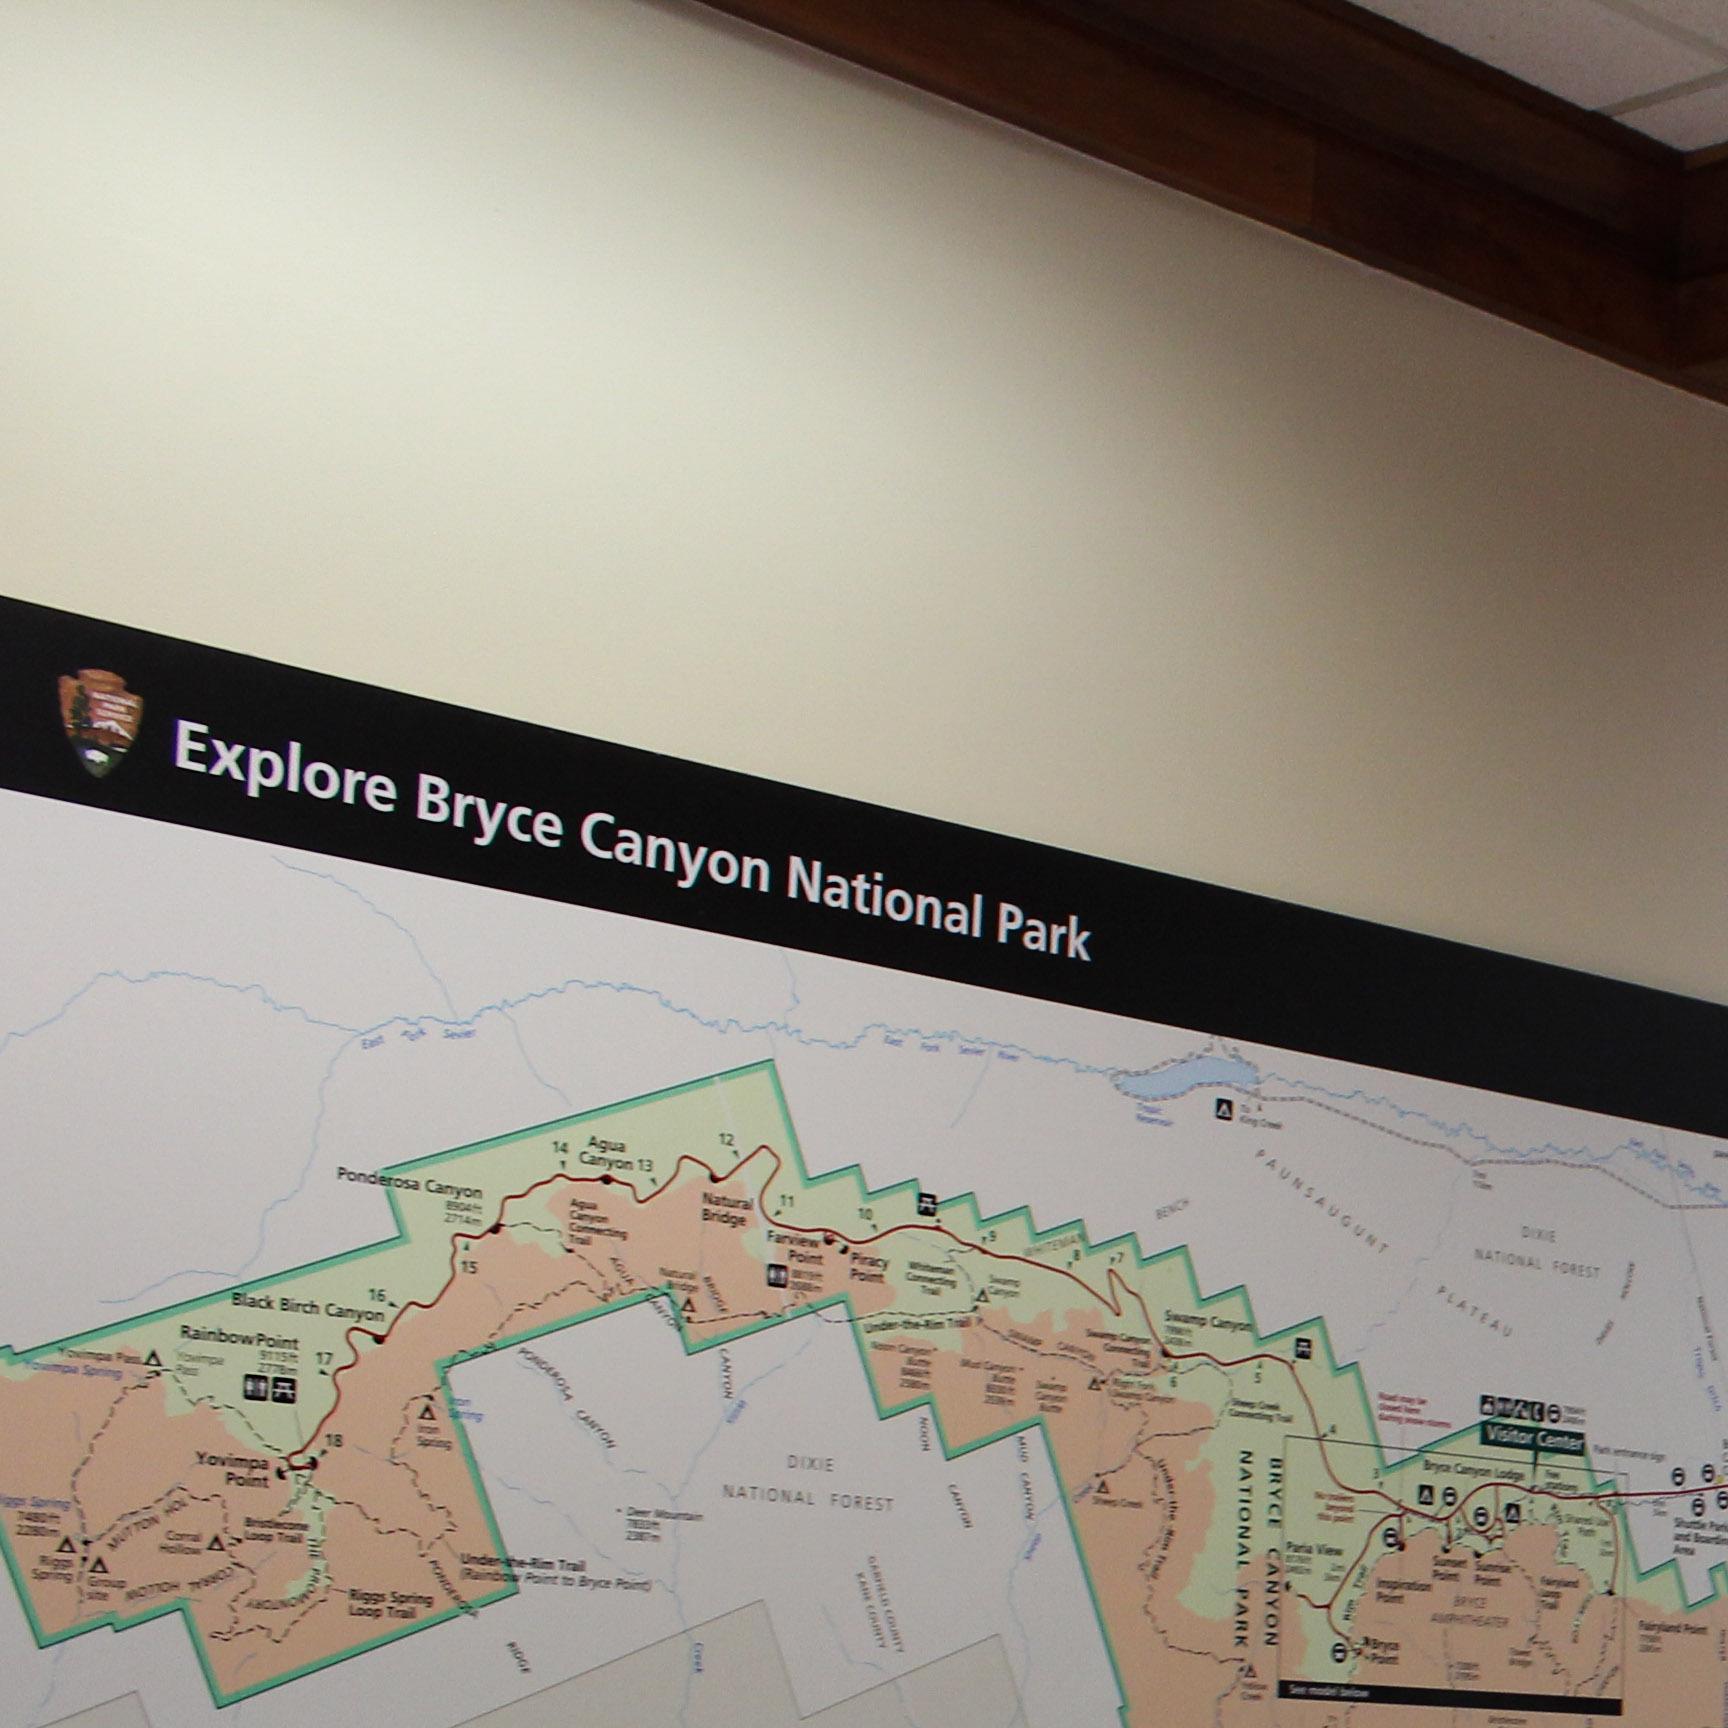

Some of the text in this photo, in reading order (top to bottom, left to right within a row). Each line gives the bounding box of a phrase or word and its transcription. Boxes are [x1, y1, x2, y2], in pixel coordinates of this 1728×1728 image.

[172, 717, 1092, 962] Explore Bryce Canyon National Park
[589, 1136, 626, 1153] Agua
[719, 1133, 735, 1146] 12
[579, 1151, 634, 1171] Canyon
[637, 1159, 654, 1172] 13
[336, 1166, 483, 1200] Ponderosa Canyon
[702, 1192, 754, 1211] Natural
[702, 1209, 747, 1229] Bridge
[788, 1251, 824, 1265] Point
[851, 1252, 889, 1270] Piracy
[460, 1261, 478, 1275] 15
[851, 1269, 884, 1283] Point
[369, 1289, 385, 1302] 16
[231, 1292, 385, 1323] Black Birch Canyon
[181, 1325, 299, 1351] Rainbow Point
[316, 1352, 334, 1365] 17
[326, 1433, 343, 1447] 18
[1486, 1424, 1585, 1451] Visitor Center
[196, 1451, 269, 1470] Yovimpa
[786, 1453, 836, 1472] DIXIE
[1423, 1458, 1525, 1482] Bryce Canyon Lodge
[226, 1471, 270, 1489] Point
[722, 1483, 895, 1513] NATIONAL FOREST
[1234, 1450, 1255, 1648] NATIONAL PARK
[1264, 1458, 1283, 1647] BRYCE CANYON
[558, 1558, 587, 1573] Trail
[348, 1587, 434, 1609] Riggs Spring
[348, 1604, 417, 1620] Loop Trail
